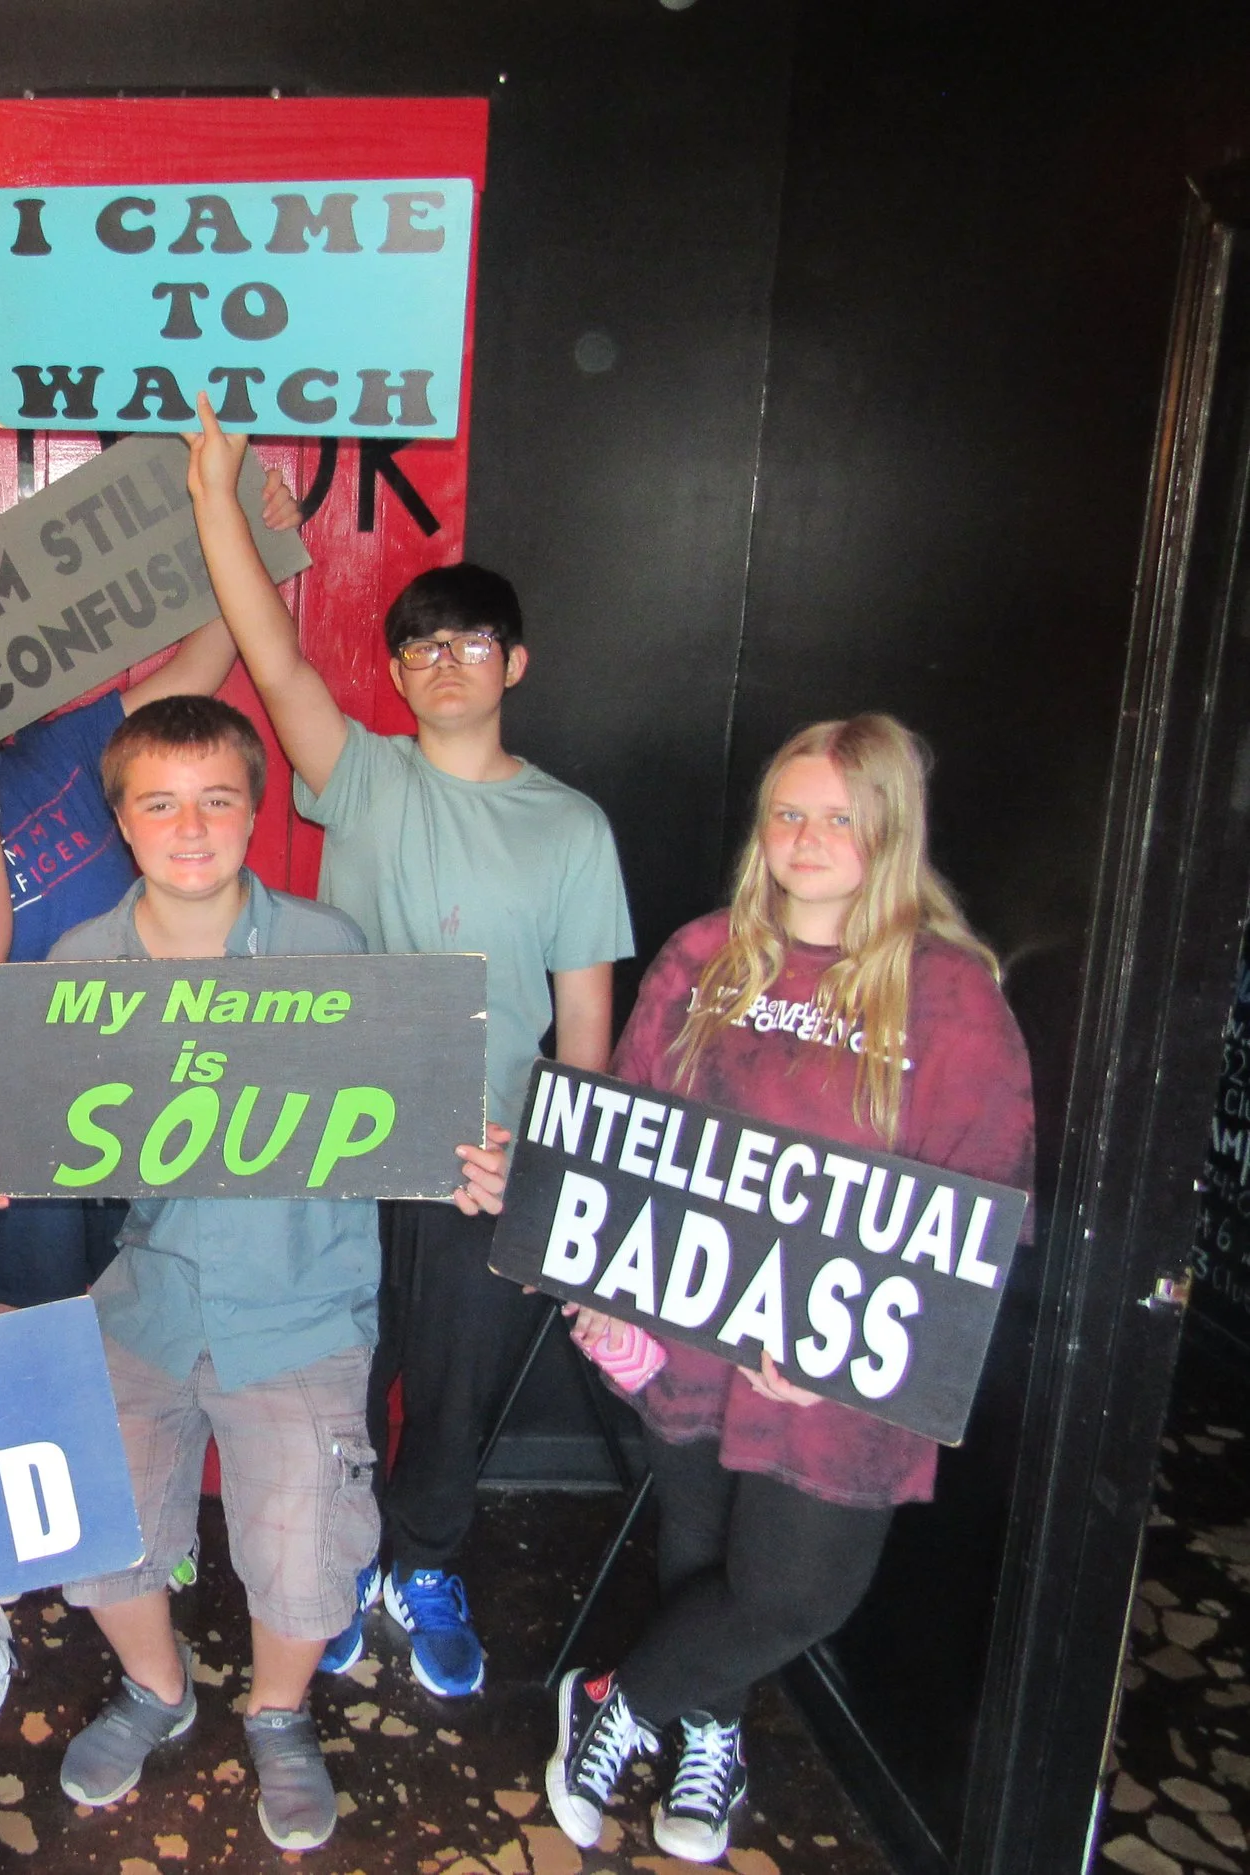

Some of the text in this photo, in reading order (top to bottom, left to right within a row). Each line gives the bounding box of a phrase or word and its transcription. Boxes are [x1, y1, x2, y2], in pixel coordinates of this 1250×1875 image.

[10, 191, 446, 256] I CAME
[152, 281, 289, 341] TO
[11, 365, 437, 426] WATCH
[46, 979, 351, 1035] My Name
[170, 1040, 228, 1083] is
[52, 1082, 396, 1188] SOUP
[526, 1070, 1001, 1289] INTELLECTUAL
[541, 1169, 920, 1400] BADASS
